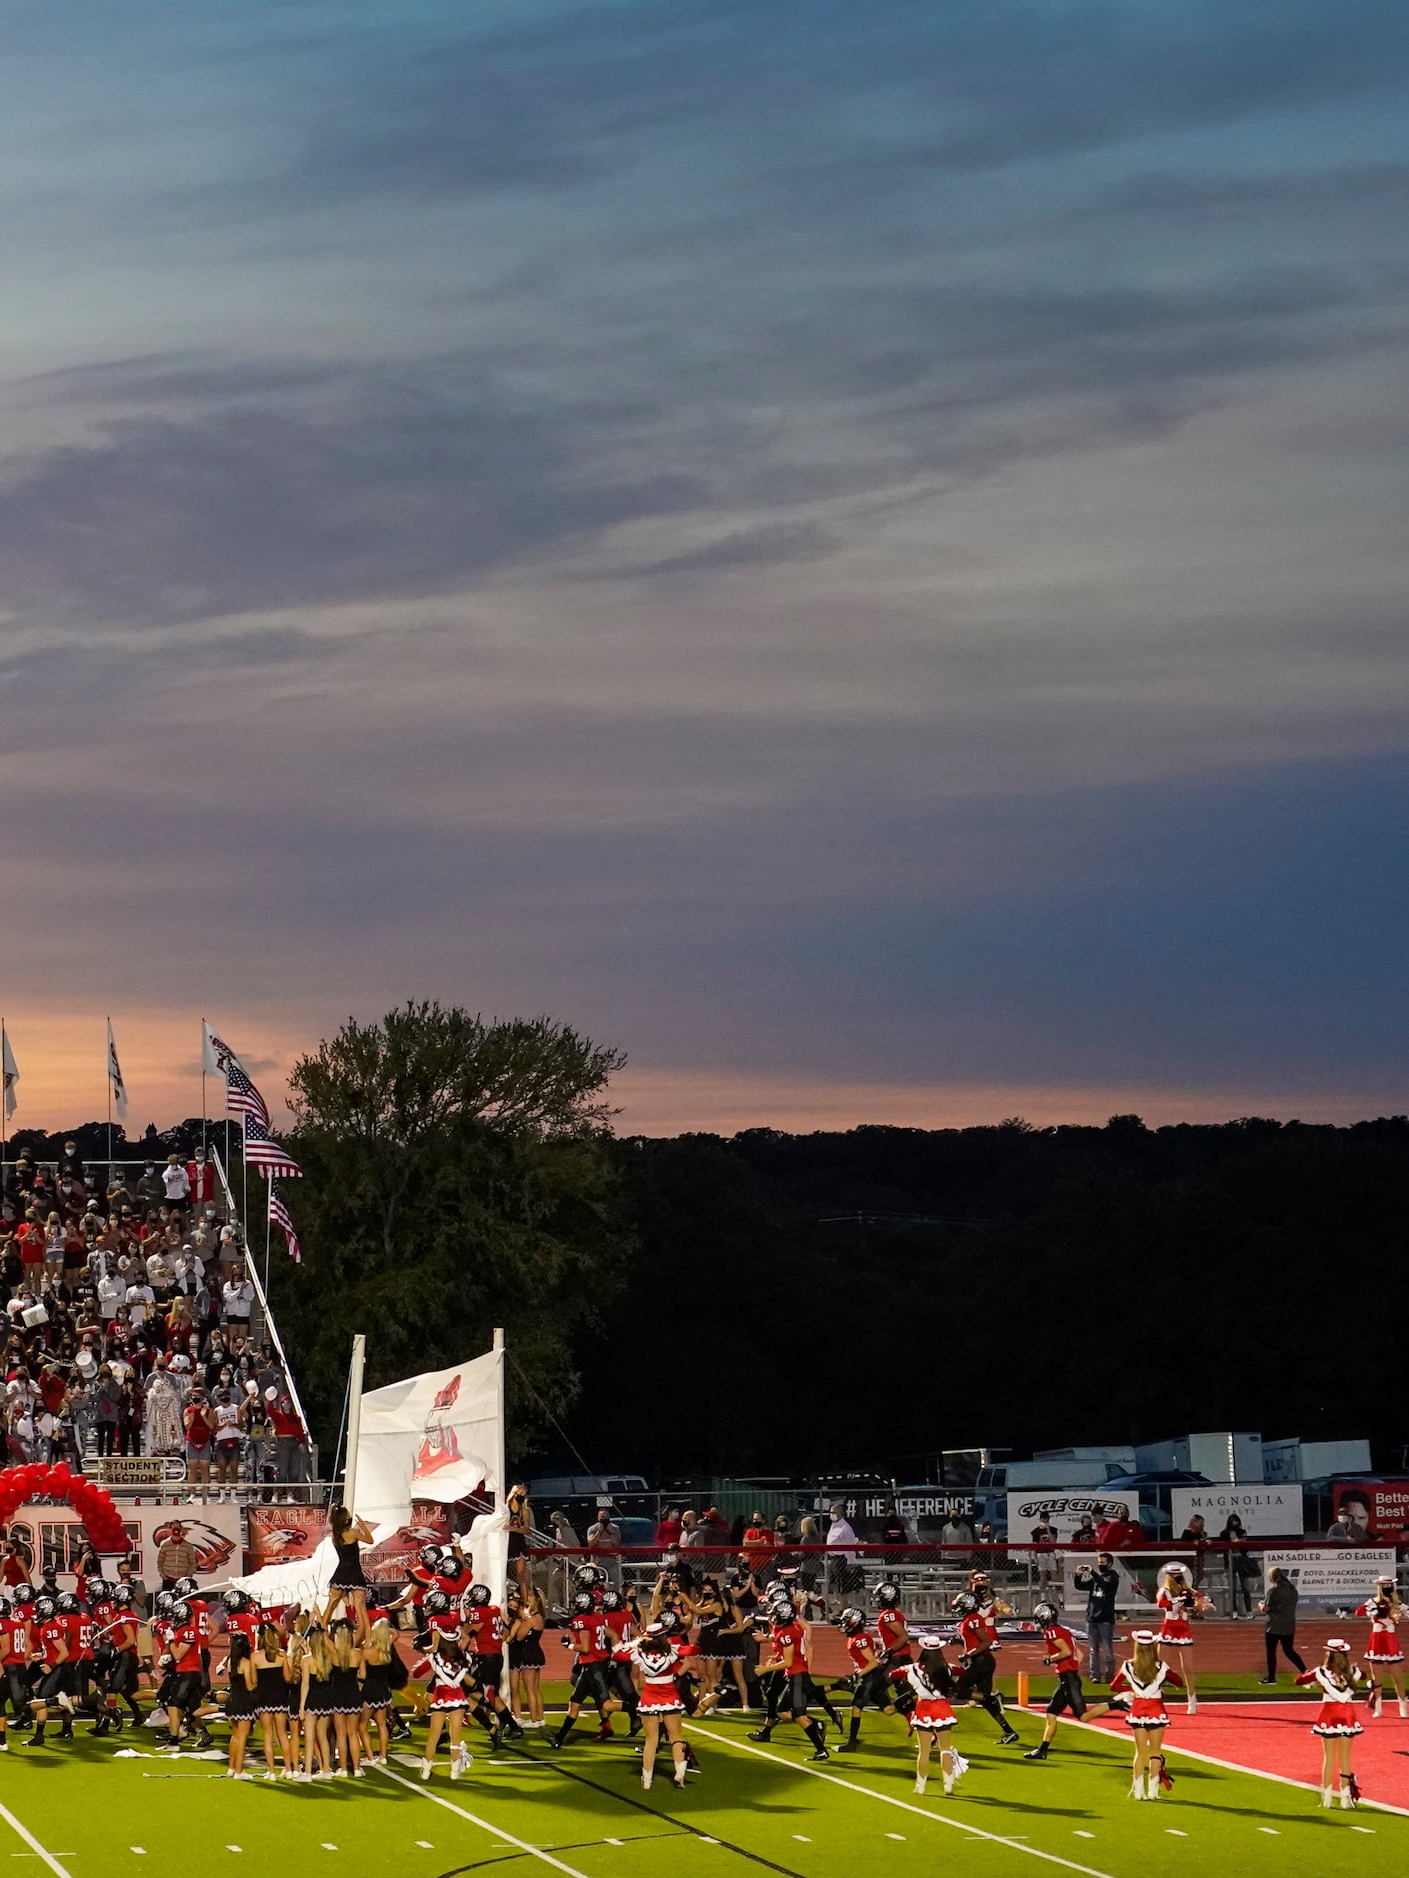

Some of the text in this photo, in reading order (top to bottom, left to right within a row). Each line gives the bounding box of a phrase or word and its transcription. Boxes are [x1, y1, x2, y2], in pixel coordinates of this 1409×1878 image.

[105, 1461, 157, 1471] STUDENT
[106, 1472, 157, 1483] SECTION
[1191, 1495, 1284, 1507] MAGNOLIA
[1019, 1499, 1069, 1518] CYCLE
[1375, 1505, 1405, 1517] Best
[256, 1508, 326, 1526] EAGLE
[1267, 1553, 1285, 1562] IAN
[1354, 1551, 1392, 1561] EAGLES!
[1327, 1568, 1381, 1577] SHACKELFORD,
[98, 1606, 109, 1615] 20
[883, 1613, 896, 1623] 58
[227, 1620, 239, 1630] 72
[573, 1620, 584, 1630] 36
[967, 1618, 980, 1629] 47
[46, 1629, 58, 1639] 38
[182, 1630, 195, 1640] 42
[1047, 1630, 1057, 1640] 11
[13, 1628, 26, 1654] 88
[855, 1638, 868, 1648] 26
